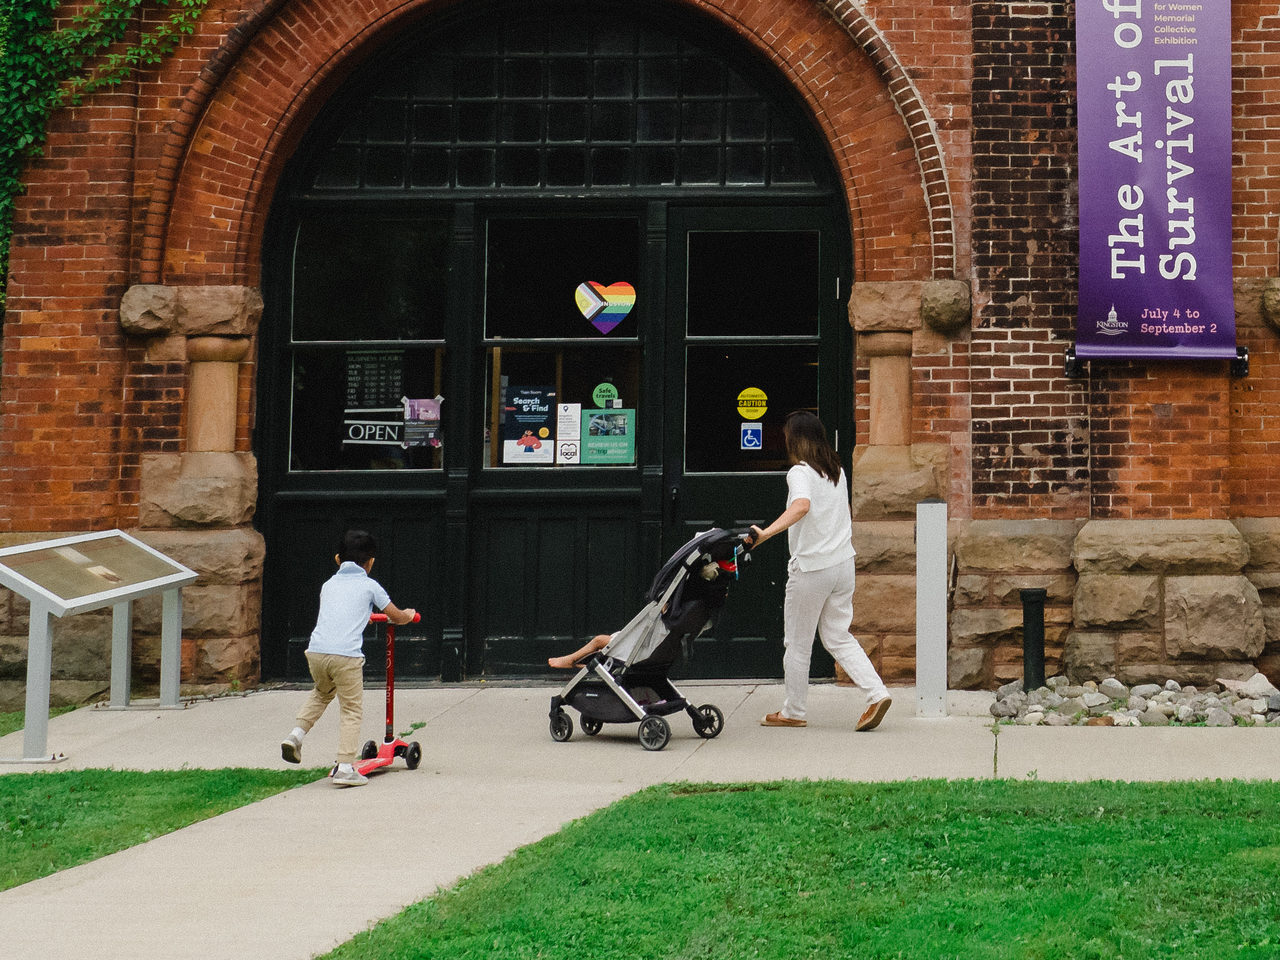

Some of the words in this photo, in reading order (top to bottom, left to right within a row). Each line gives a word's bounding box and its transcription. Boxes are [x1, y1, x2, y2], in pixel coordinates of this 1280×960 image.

[1154, 3, 1167, 11] for
[1168, 3, 1203, 11] Women
[1154, 14, 1195, 22] Memorial
[1154, 25, 1196, 33] Collective
[1154, 36, 1198, 45] Exhibition
[1106, 70, 1143, 164] Art
[1154, 52, 1197, 281] Survival
[1107, 184, 1146, 279] The
[1141, 308, 1168, 321] July
[1173, 308, 1181, 319] 4
[1185, 308, 1200, 319] to
[1096, 320, 1129, 328] KINGSTON
[1140, 323, 1206, 335] September
[1210, 323, 1217, 333] 2
[513, 397, 540, 405] Search
[522, 404, 530, 412] &
[531, 404, 549, 412] Find
[348, 424, 399, 440] OPEN
[560, 448, 578, 457] local
